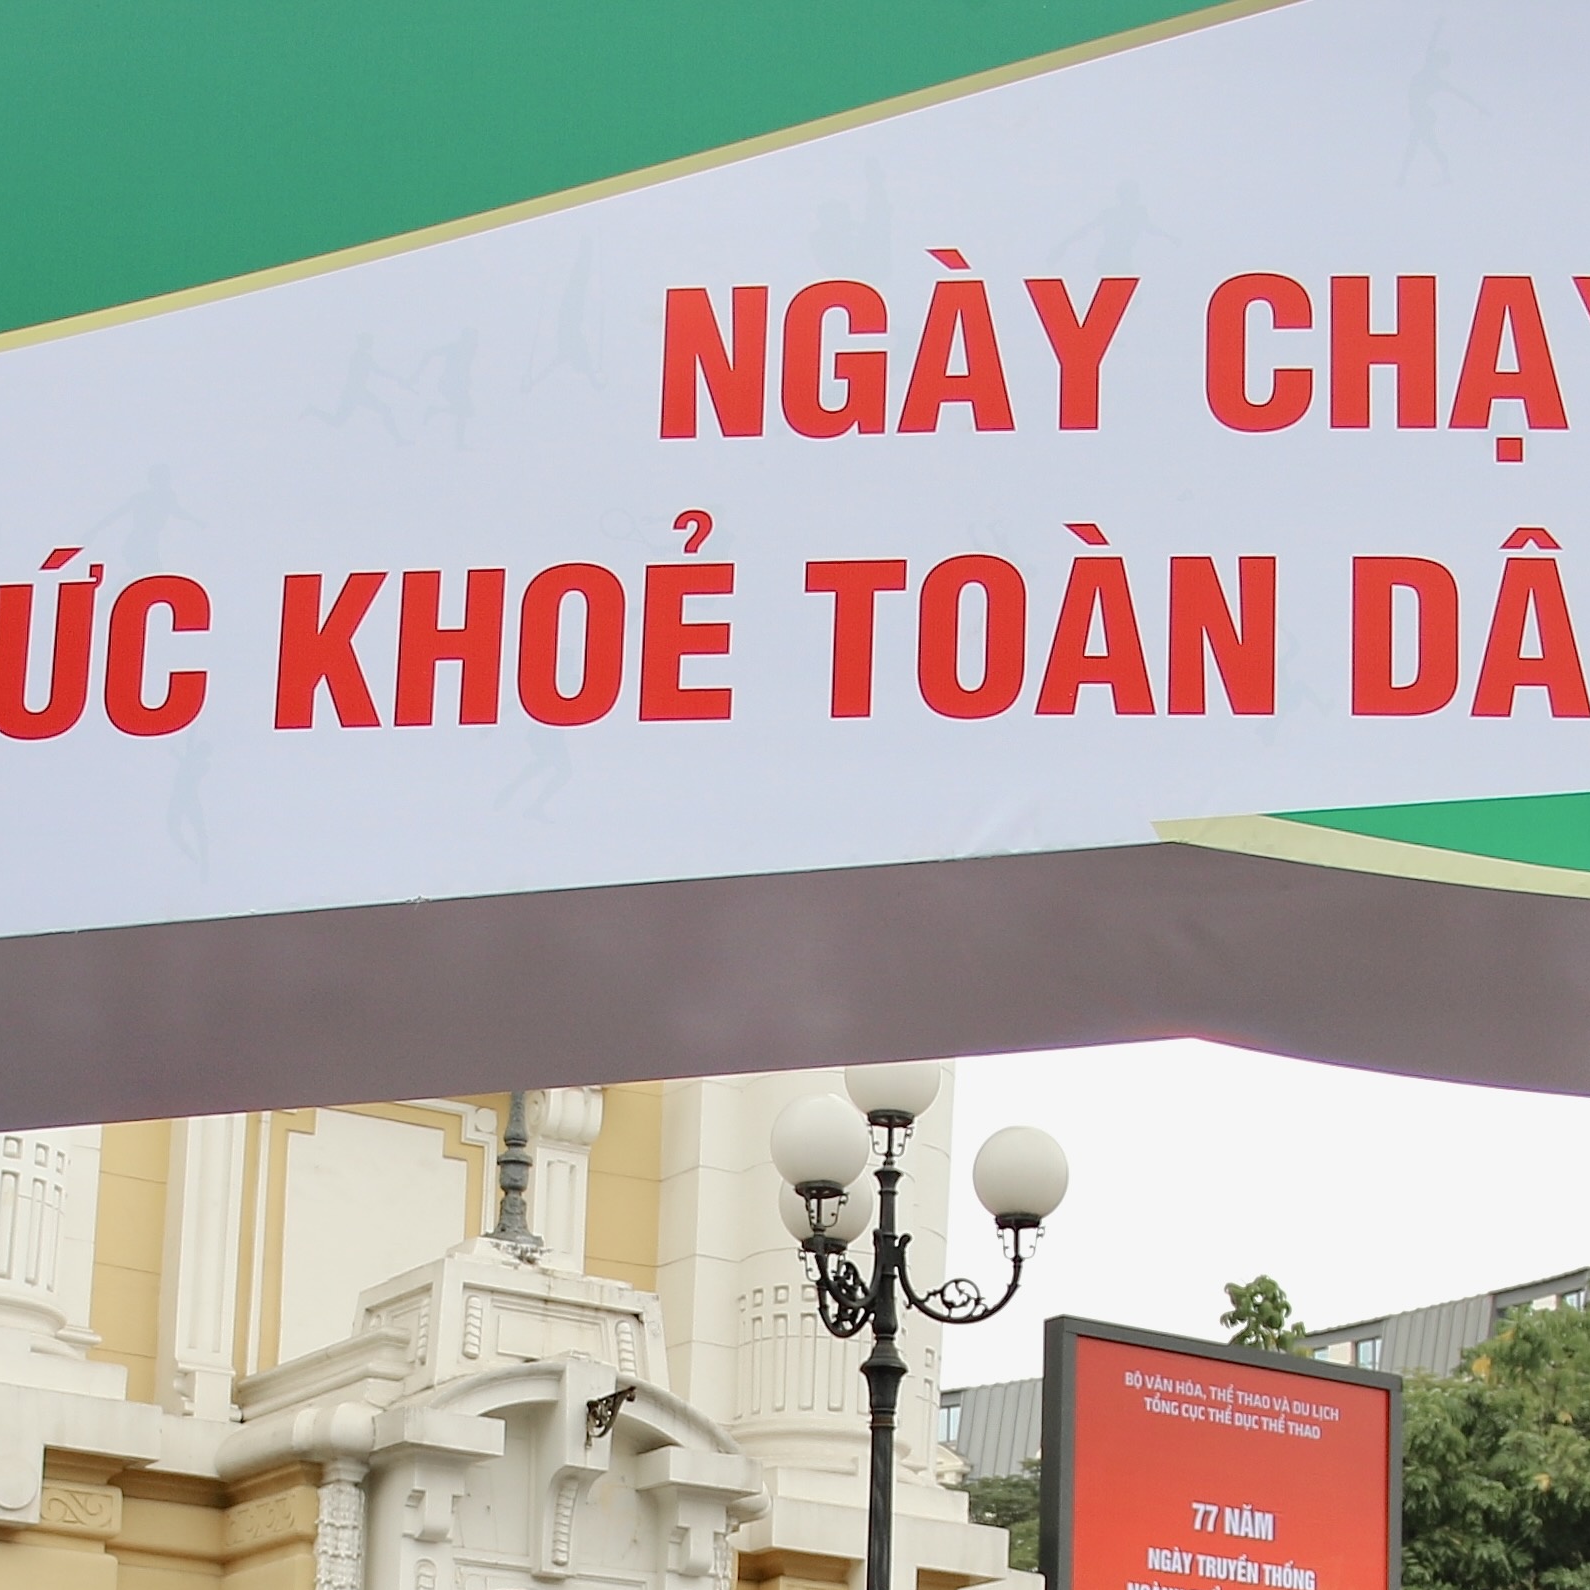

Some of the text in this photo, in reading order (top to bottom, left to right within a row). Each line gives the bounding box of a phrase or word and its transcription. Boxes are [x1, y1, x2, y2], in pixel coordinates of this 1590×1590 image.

[659, 248, 1139, 439] NGÀY
[274, 509, 736, 730] KHOẺ
[805, 522, 1277, 720] TOÀN
[1125, 1371, 1142, 1388] BỘ
[1145, 1373, 1172, 1393] VĂN
[1210, 1384, 1234, 1404] THỂ
[1237, 1390, 1270, 1409] THAO
[1273, 1394, 1290, 1413] VÀ
[1293, 1402, 1310, 1416] DU
[1312, 1405, 1339, 1421] LỊCH
[1144, 1392, 1321, 1439] TỔNG CỤC THỂ DỤC THỂ THAO
[1192, 1502, 1274, 1541] 77 NĂM
[1147, 1546, 1192, 1575] NGÀY
[1196, 1553, 1259, 1584] TRUYỀN
